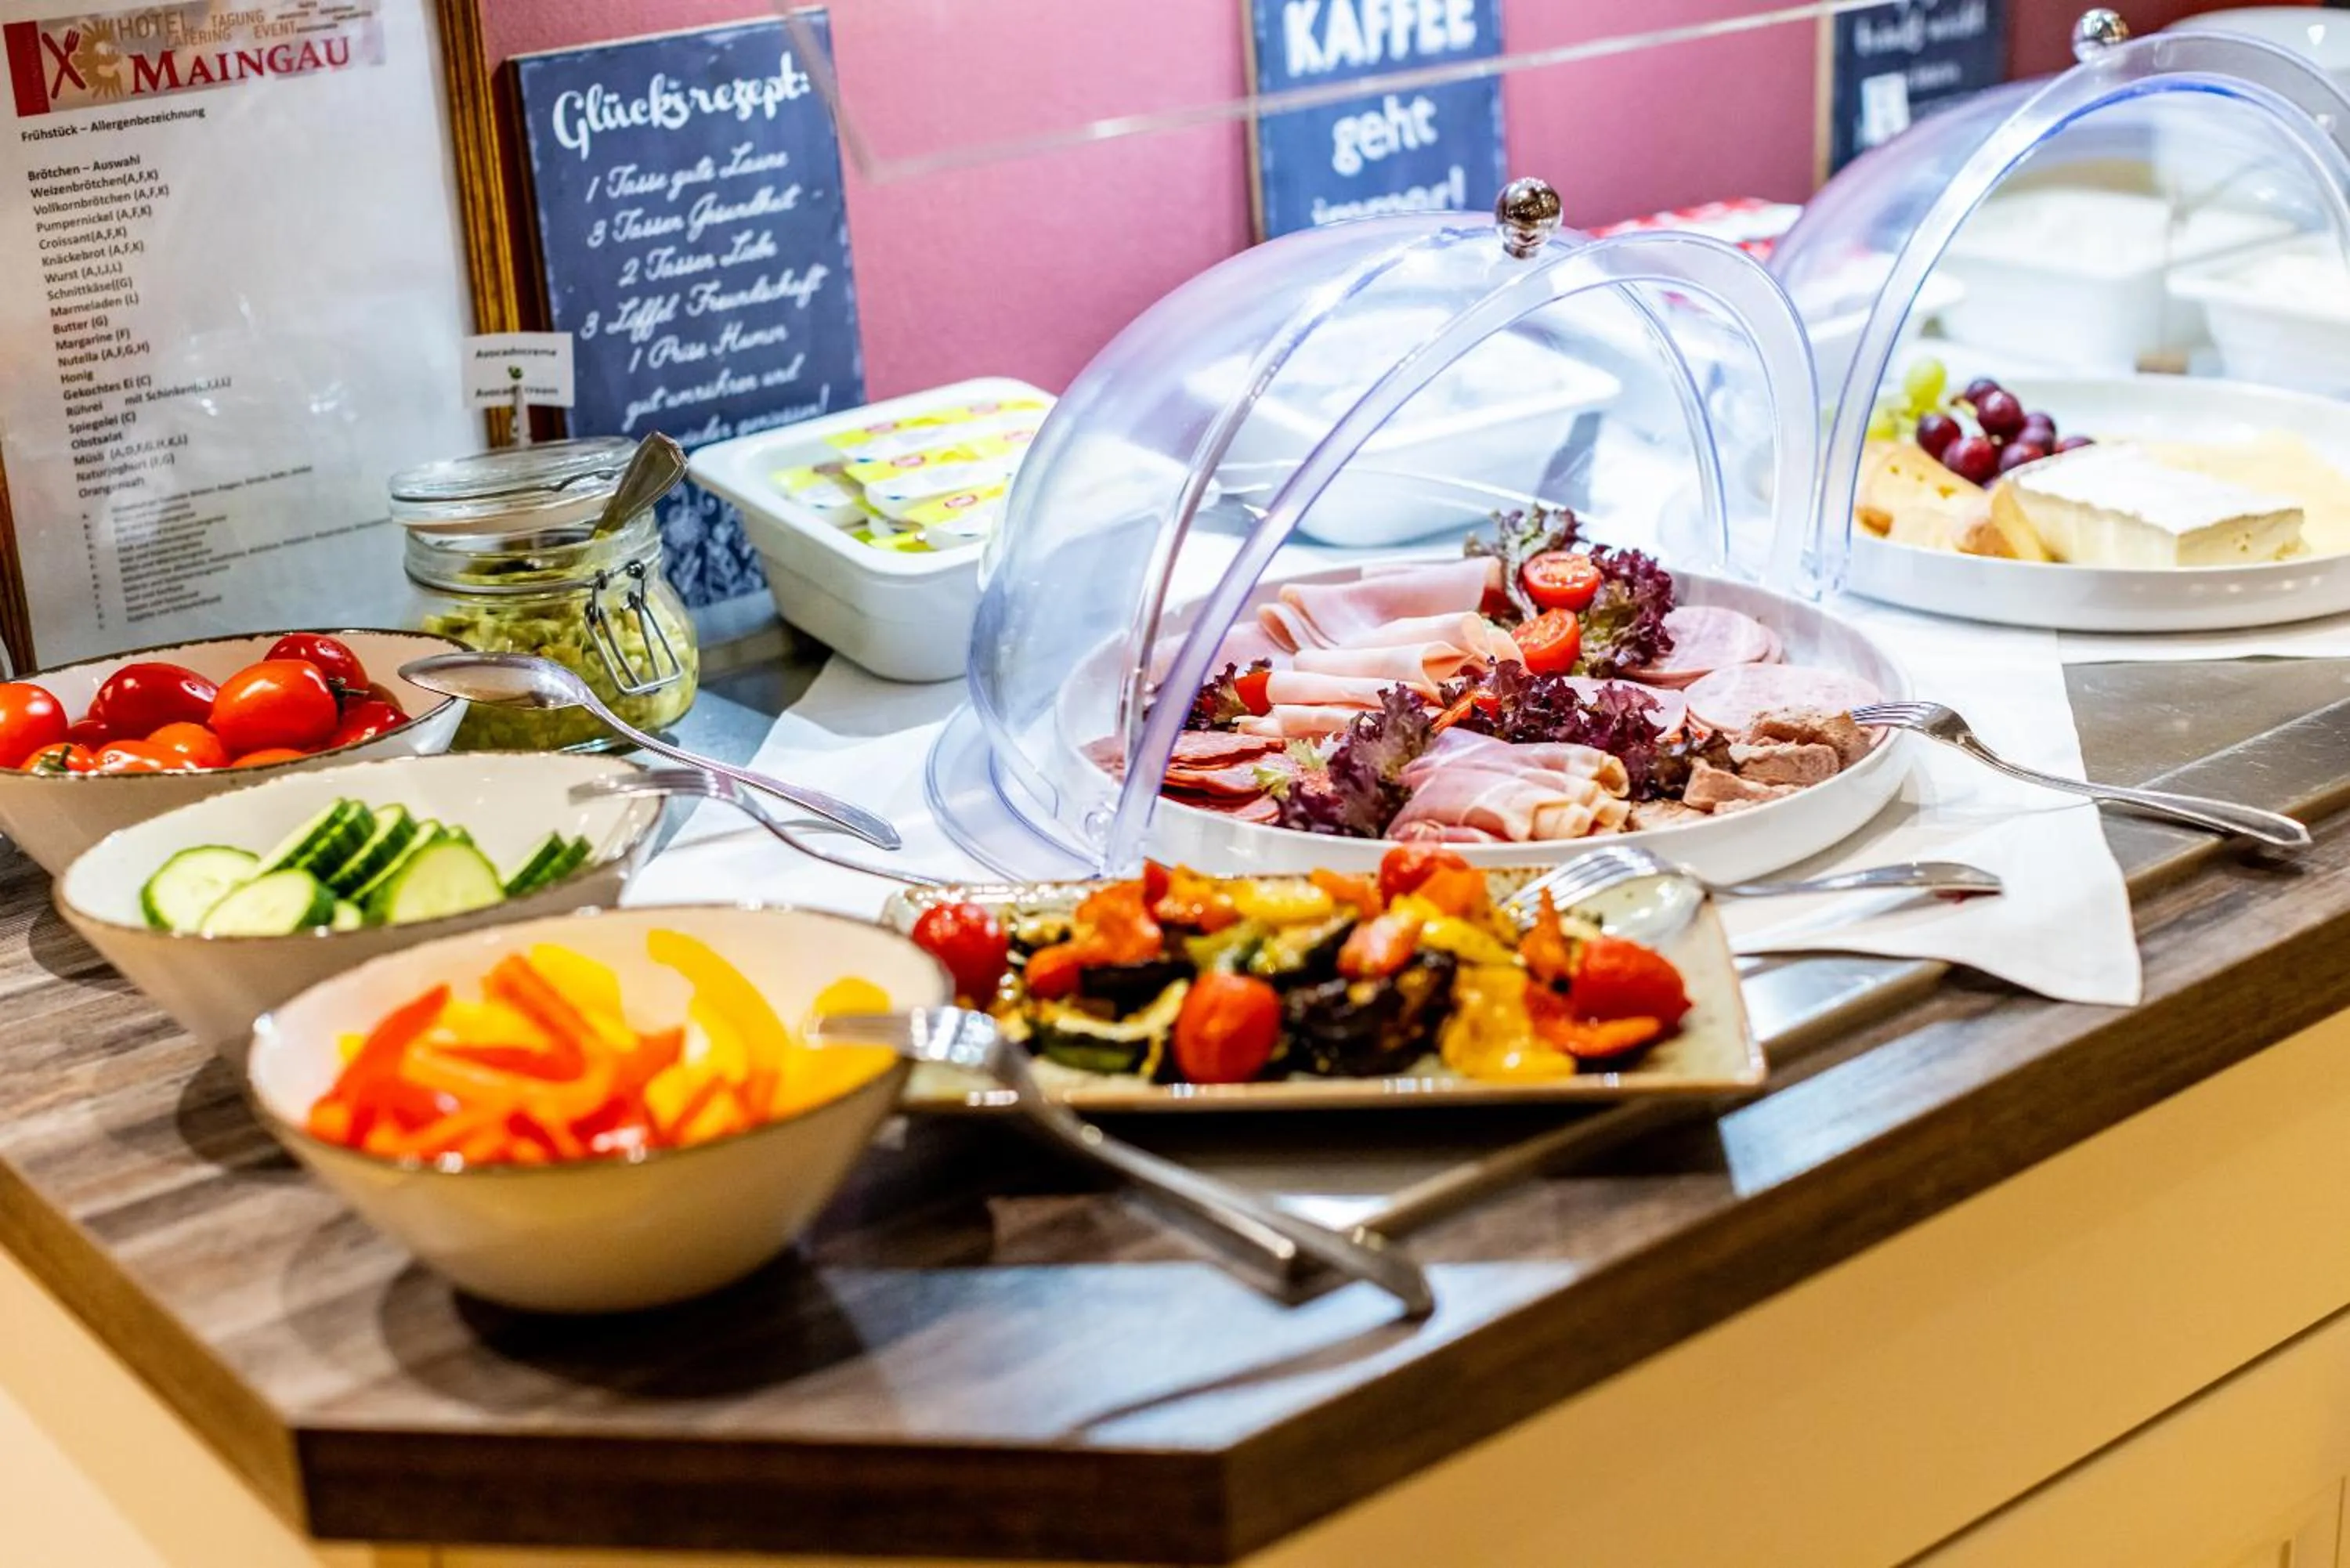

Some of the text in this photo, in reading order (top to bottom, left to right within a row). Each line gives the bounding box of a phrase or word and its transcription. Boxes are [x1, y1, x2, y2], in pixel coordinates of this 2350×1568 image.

[118, 9, 187, 41] HOTEL
[212, 9, 265, 28] TAGUNG
[253, 21, 296, 39] EVENT
[1282, 0, 1477, 78] KAFFEE
[128, 36, 349, 94] MAINGAU
[21, 125, 78, 142] Frühstück
[91, 107, 205, 132] Allergenbezeichnung
[1332, 94, 1439, 177] geht
[27, 165, 80, 181] Brötchen
[93, 155, 140, 172] Auswahl
[34, 191, 131, 215] Vollkornbrötchen
[37, 211, 113, 233] Pumpernickel
[42, 248, 105, 267] Knäckebrot
[45, 270, 78, 284] Wurst
[618, 257, 641, 287] 2
[50, 297, 122, 317] Marmeladen
[52, 320, 88, 334] Butter
[56, 334, 113, 351] Margarine
[58, 352, 99, 367] Nutella
[60, 370, 94, 384] Honig
[63, 382, 121, 400] Gekochtes
[71, 432, 123, 450] Obstsalat
